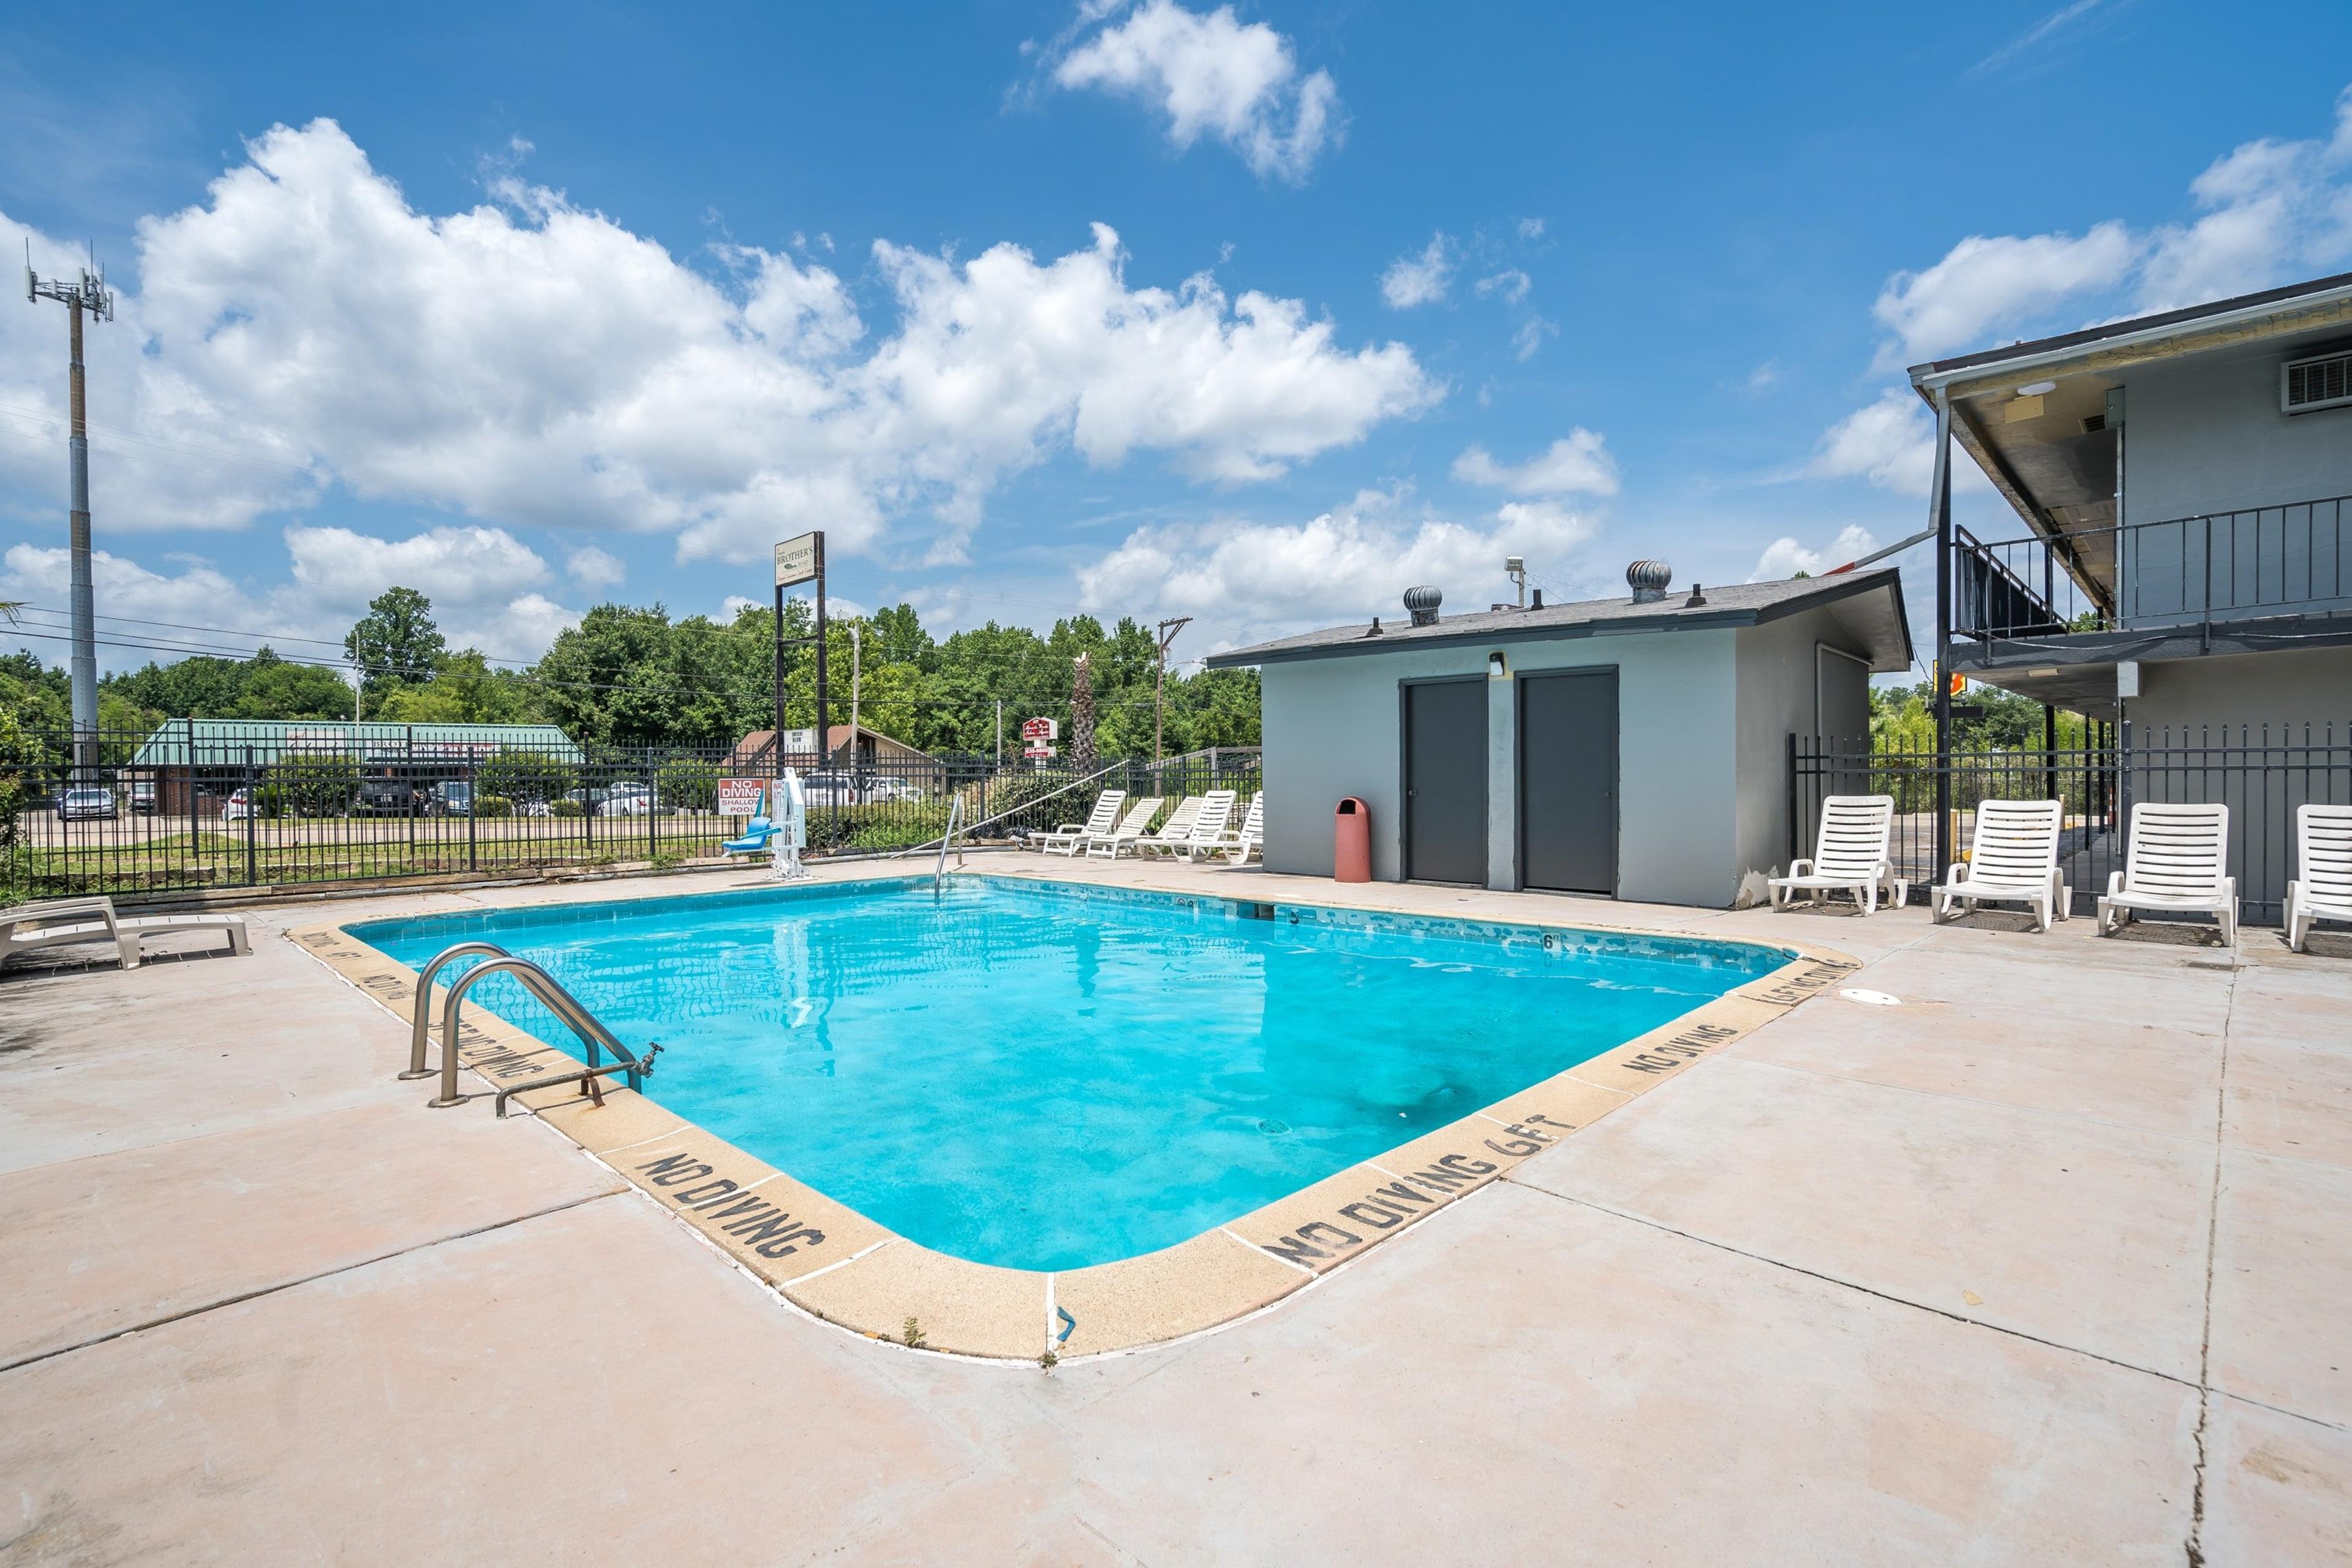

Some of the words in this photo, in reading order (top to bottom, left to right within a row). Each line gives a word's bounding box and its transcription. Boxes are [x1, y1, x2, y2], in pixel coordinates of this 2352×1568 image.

[777, 546, 813, 564] BROTHER'S
[722, 788, 761, 797] DIVING
[1544, 935, 1553, 949] 6
[463, 1045, 545, 1079] DIVING
[1621, 1054, 1681, 1074] NO
[1654, 1024, 1738, 1058] DIVING
[635, 1152, 714, 1187] NO
[673, 1178, 826, 1259] DIVING
[1262, 1221, 1364, 1268] NO
[1336, 1153, 1498, 1229] DIVING
